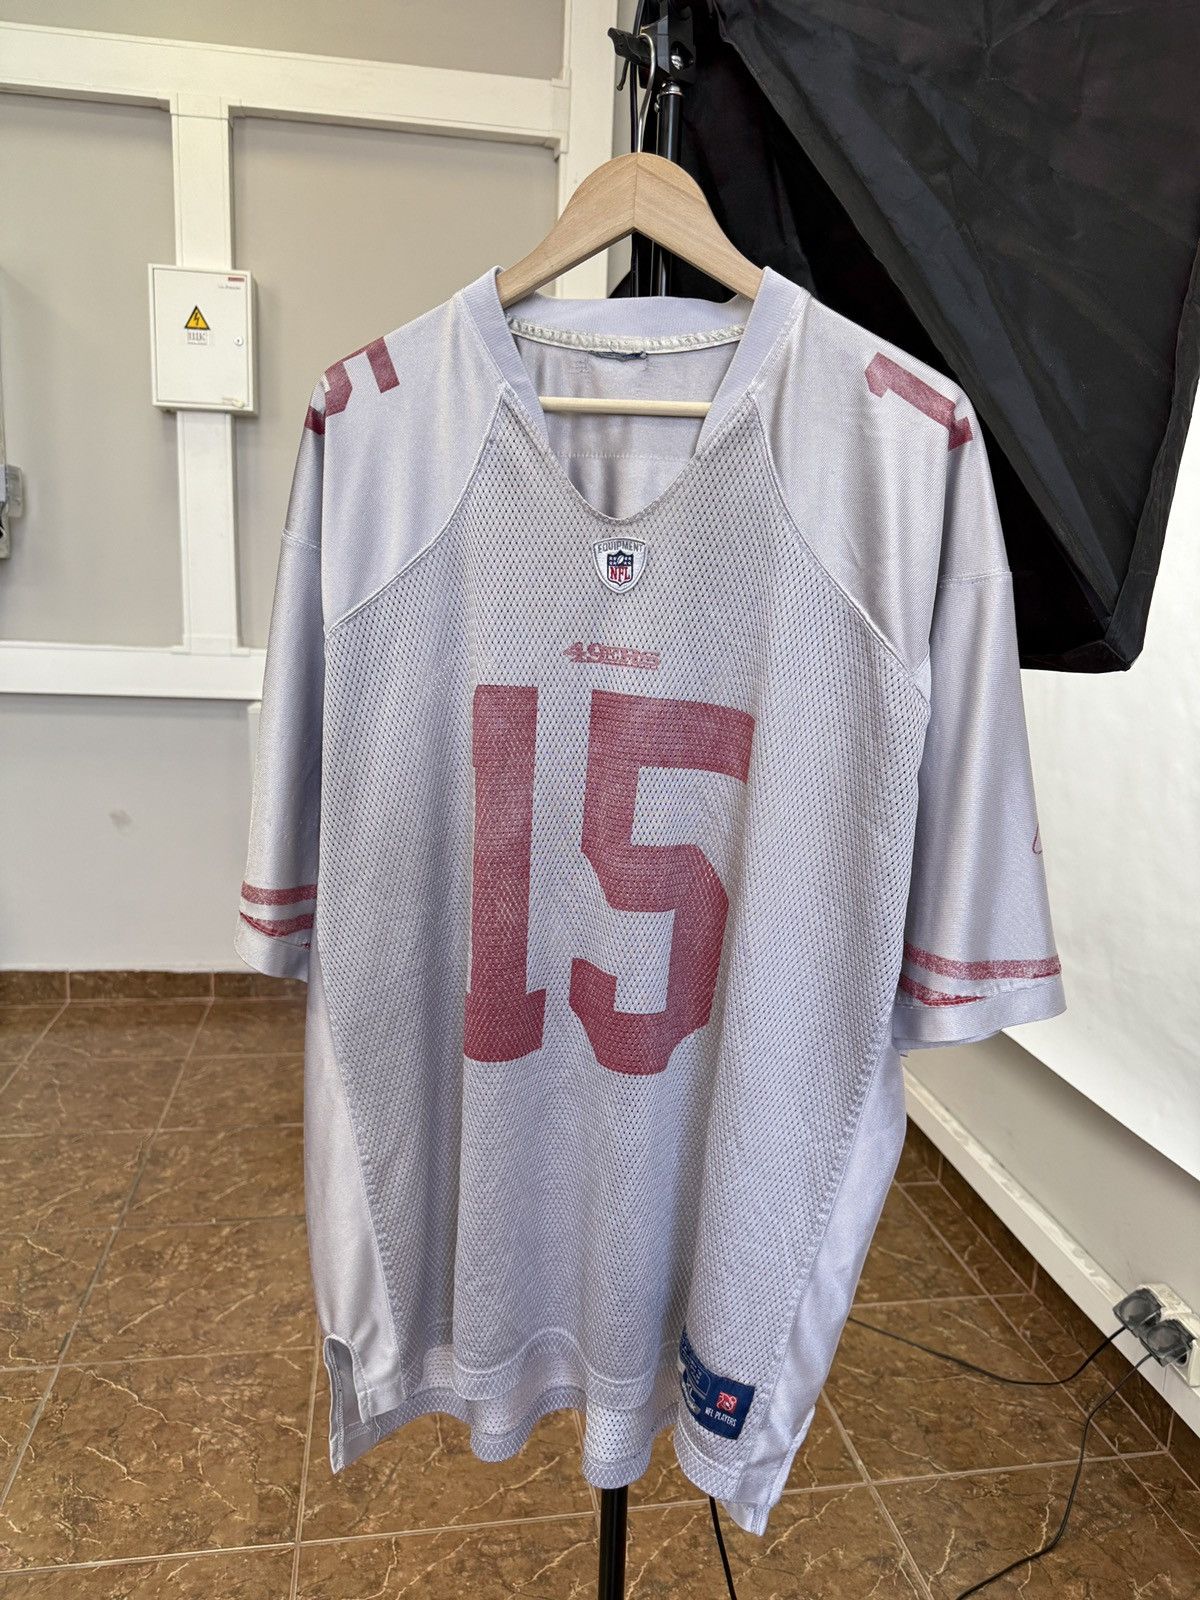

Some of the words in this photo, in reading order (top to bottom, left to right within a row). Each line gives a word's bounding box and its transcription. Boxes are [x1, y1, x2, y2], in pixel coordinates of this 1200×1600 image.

[597, 541, 644, 553] EQUIPMENT
[609, 566, 631, 581] NFL
[464, 684, 755, 1075] 15
[705, 1406, 714, 1418] NFL
[714, 1411, 737, 1427] PLAYERS
